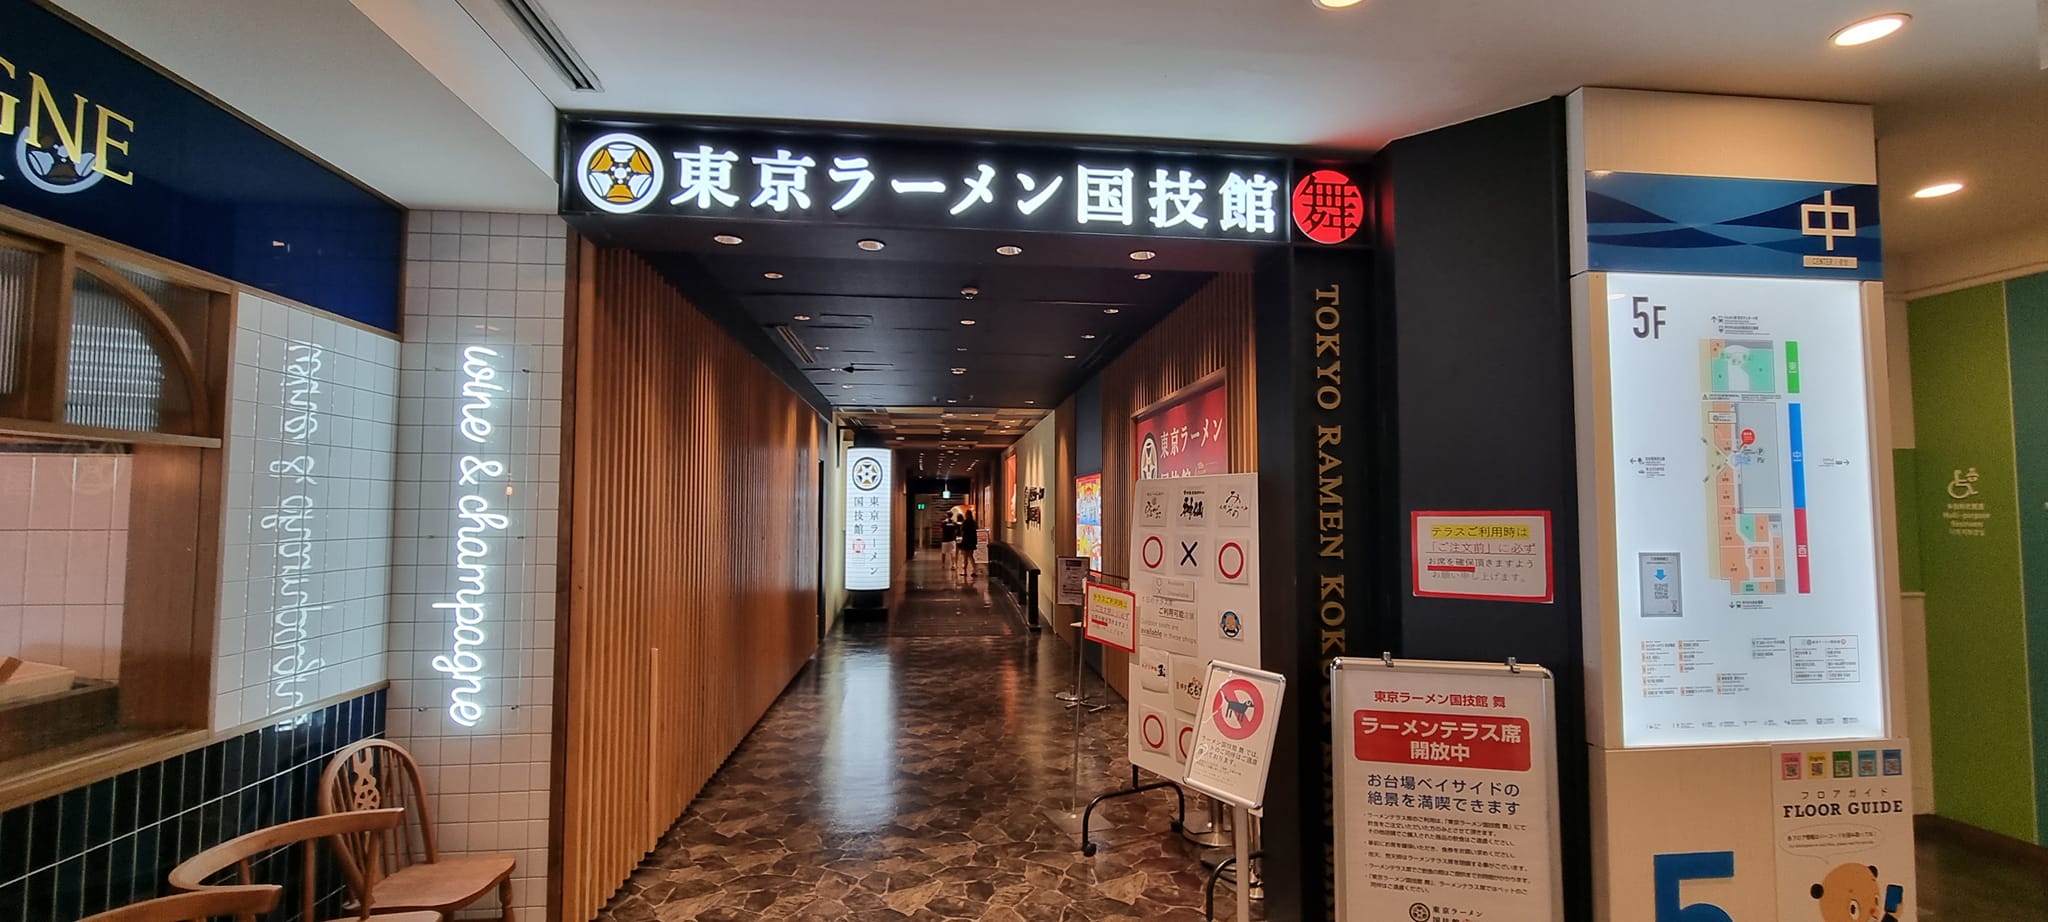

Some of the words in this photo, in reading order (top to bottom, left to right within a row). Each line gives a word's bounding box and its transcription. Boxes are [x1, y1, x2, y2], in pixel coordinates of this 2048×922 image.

[670, 145, 1279, 233] 東京ラーメン国技館
[1299, 174, 1360, 240] 舞
[1801, 190, 1857, 251] 中
[1632, 296, 1667, 339] 5F
[1315, 284, 1342, 410] TOKYO
[459, 344, 506, 444] wine
[1160, 417, 1223, 459] 東京ラーメン
[459, 455, 503, 487] &
[1318, 425, 1345, 560] RAMEN
[854, 496, 864, 535] 国技館
[1431, 526, 1529, 538] テラスご利用時は
[869, 496, 880, 576] 東京ラーメン
[432, 496, 509, 729] champagne
[1374, 690, 1488, 708] 東京ラーメン国技館
[1361, 716, 1522, 744] ラーメンテラス席
[1410, 741, 1471, 762] 開放中
[1367, 773, 1520, 798] お台場ベイサイドの
[1367, 790, 1520, 815] 絶景を満喫できます
[1800, 788, 1889, 800] フロアガイド
[1783, 803, 1842, 818] FLOOR
[1848, 800, 1903, 815] GUIDE
